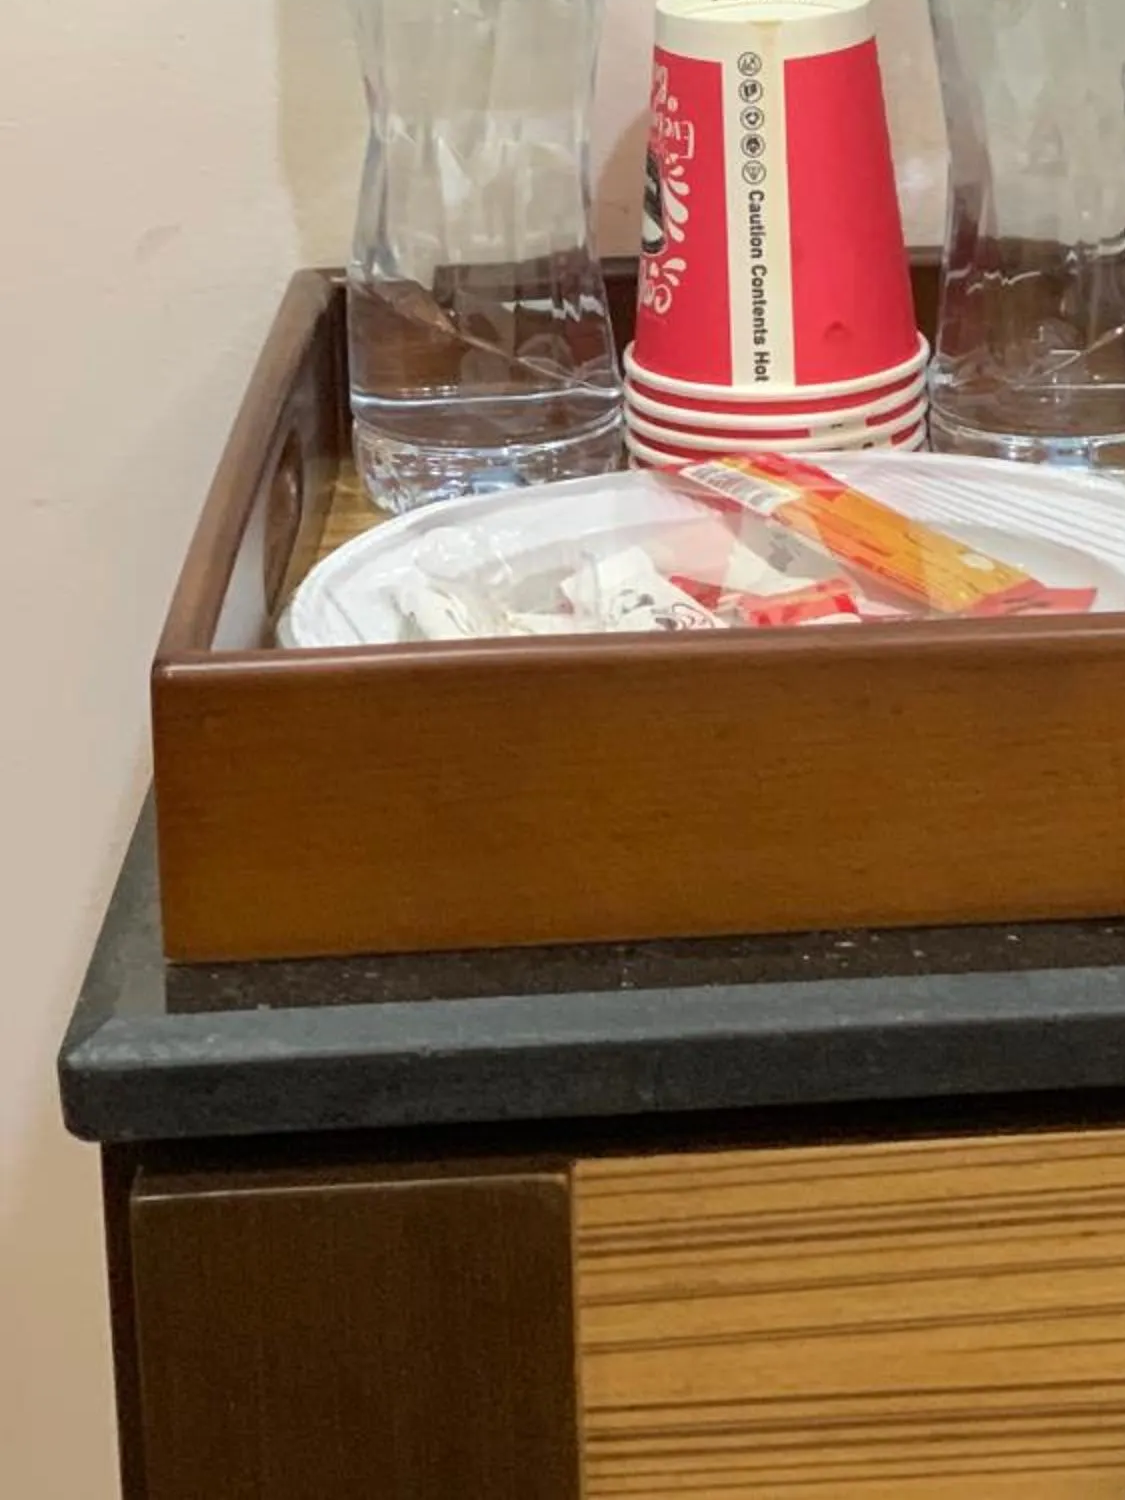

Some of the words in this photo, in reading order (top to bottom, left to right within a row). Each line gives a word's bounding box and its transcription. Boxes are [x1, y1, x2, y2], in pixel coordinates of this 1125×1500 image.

[749, 190, 765, 259] Caution
[752, 264, 768, 346] Contents
[754, 351, 770, 382] Hot
